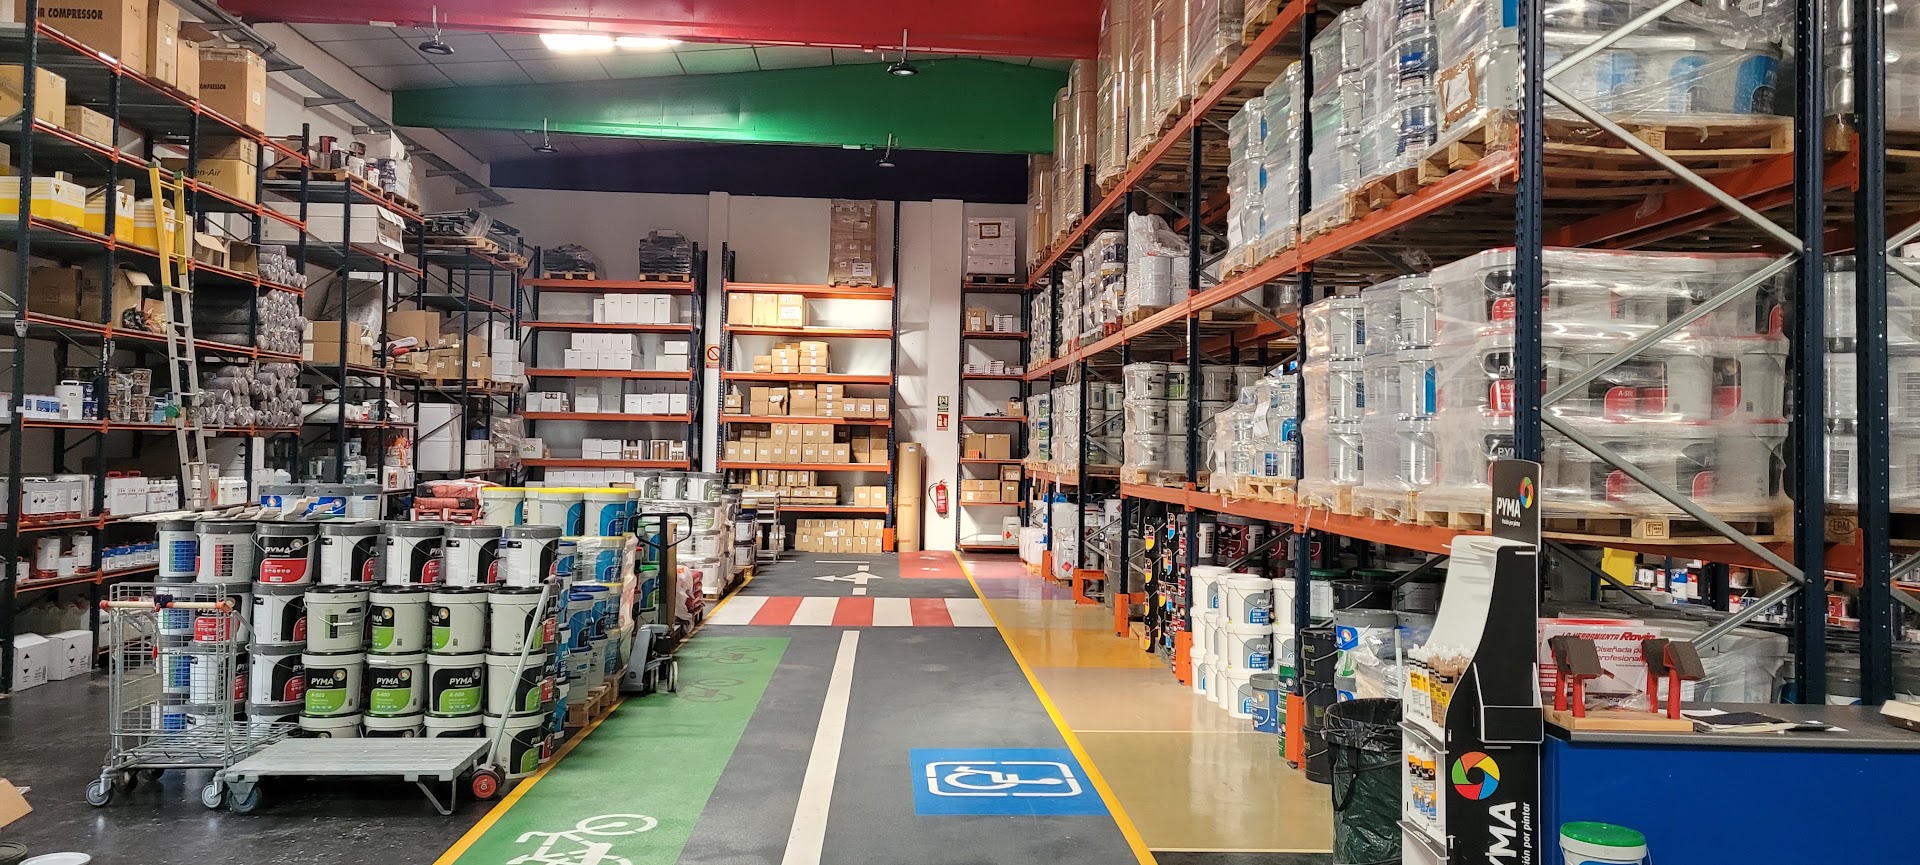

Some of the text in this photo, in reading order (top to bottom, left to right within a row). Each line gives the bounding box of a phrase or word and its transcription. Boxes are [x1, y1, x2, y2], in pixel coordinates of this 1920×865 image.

[48, 8, 103, 20] COMPRESSOR
[1496, 496, 1521, 518] PYMA
[265, 546, 290, 554] PYMA
[311, 677, 334, 686] PYMA
[376, 677, 399, 686] PYMA
[449, 676, 473, 686] PYMA
[1488, 801, 1517, 865] MA
[1521, 801, 1533, 865] ión por pintar
